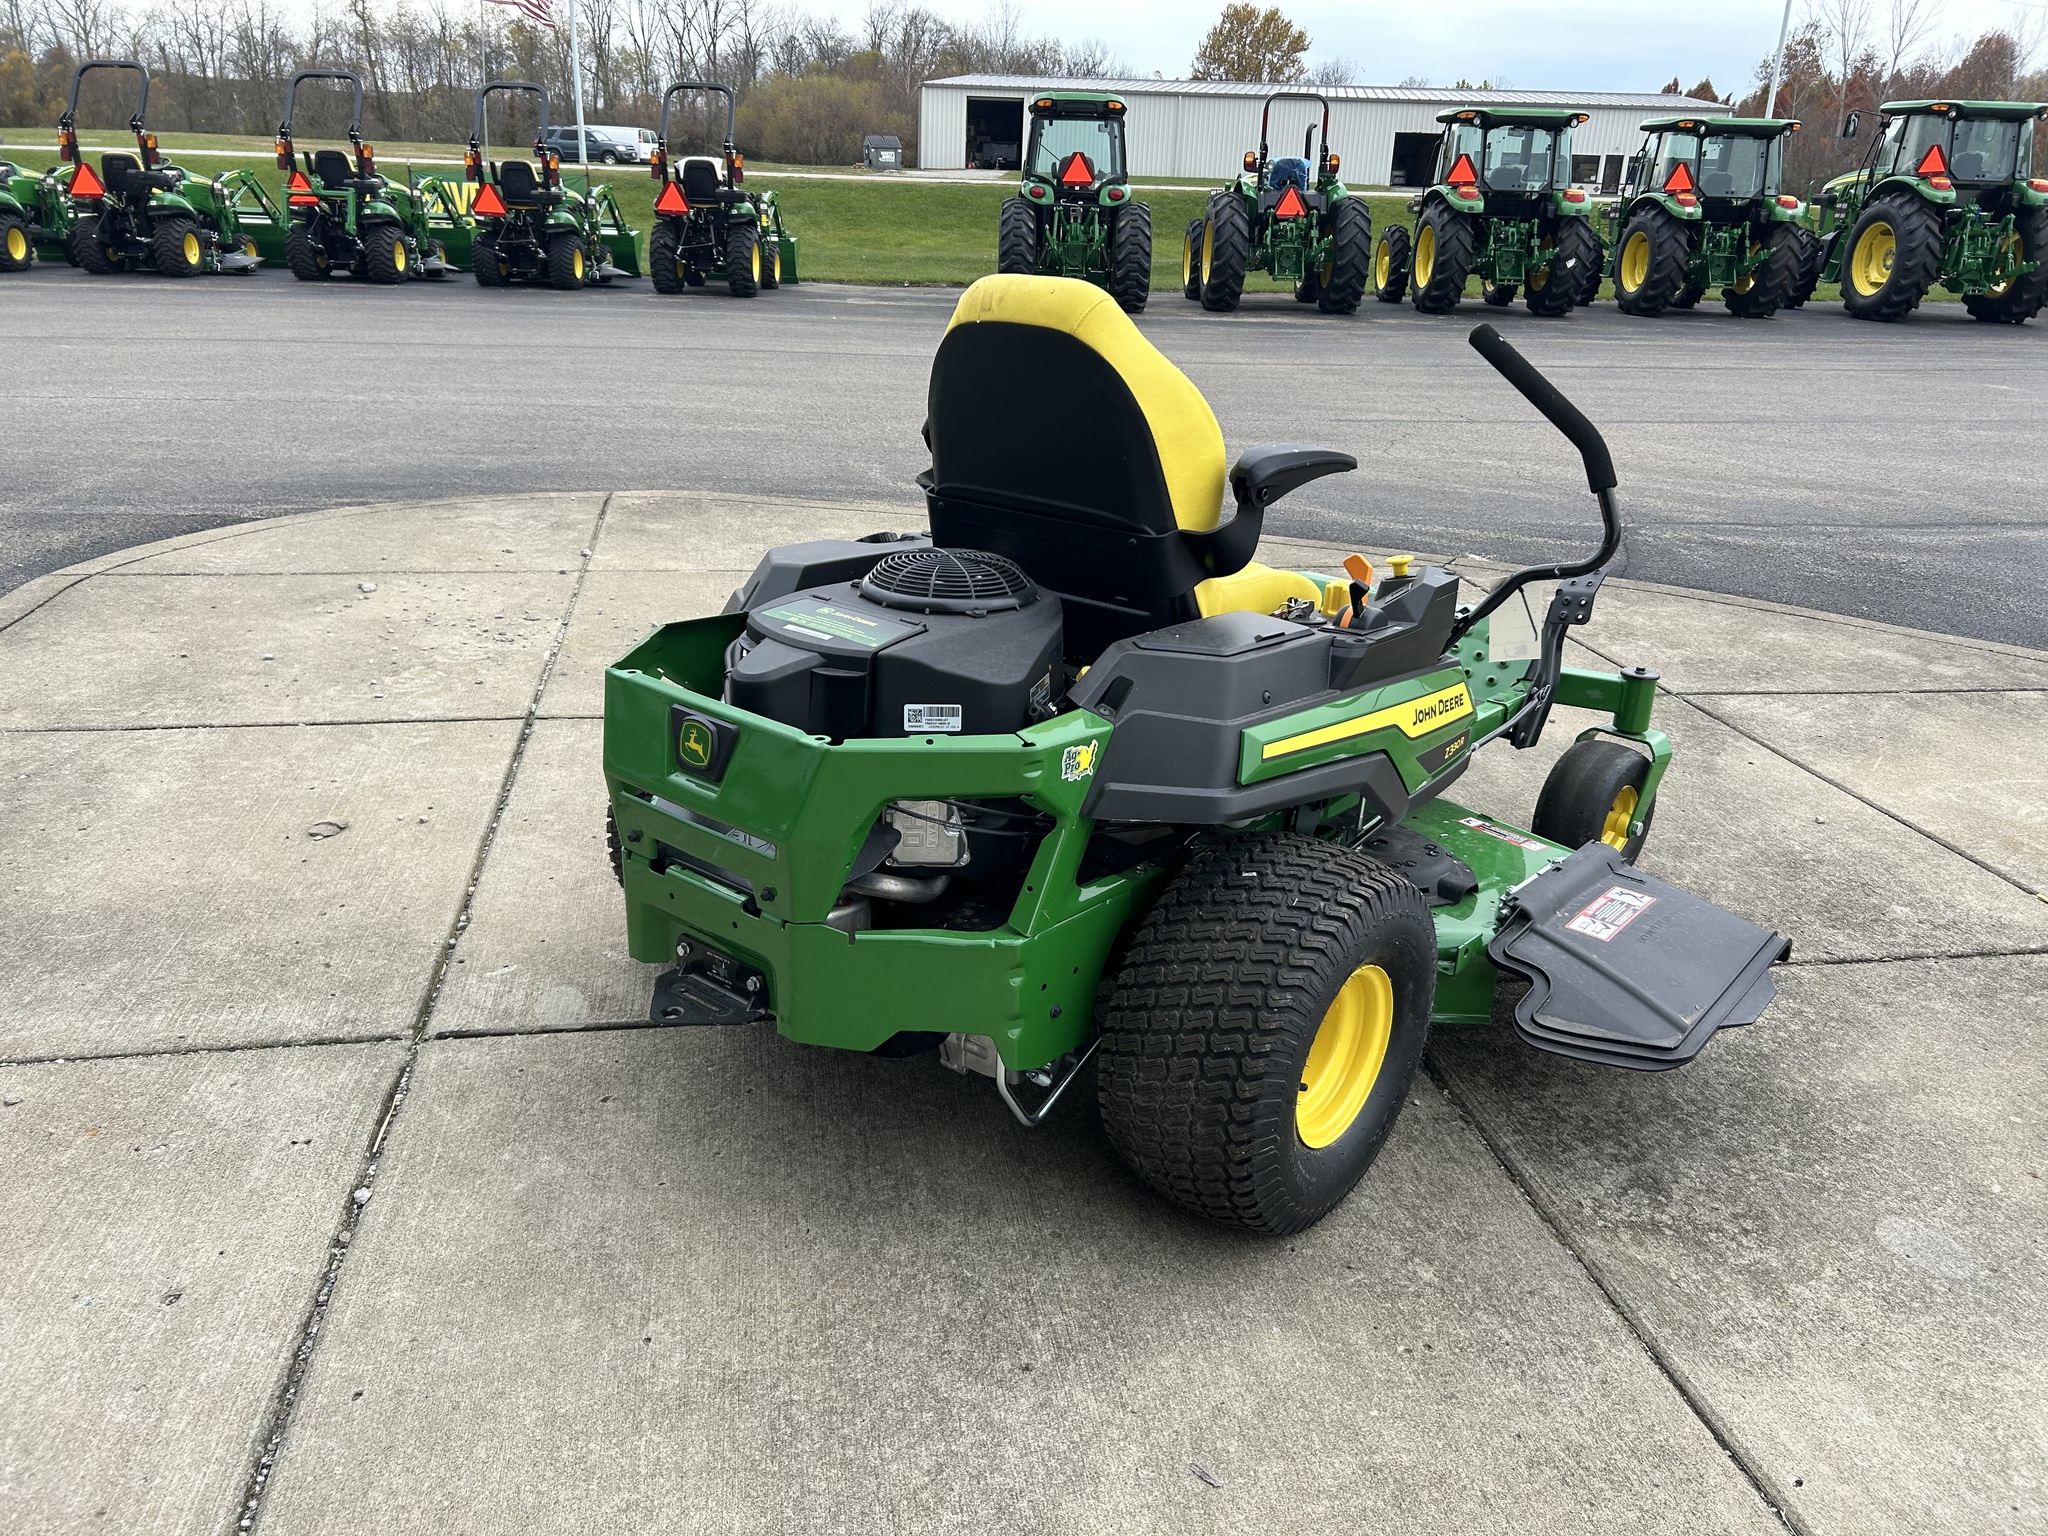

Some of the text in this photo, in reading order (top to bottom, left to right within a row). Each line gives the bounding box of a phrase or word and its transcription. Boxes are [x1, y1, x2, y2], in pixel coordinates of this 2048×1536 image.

[1412, 693, 1465, 726] JOHN DEERE
[1444, 736, 1465, 759] Z330R
[1063, 761, 1080, 775] Pro
